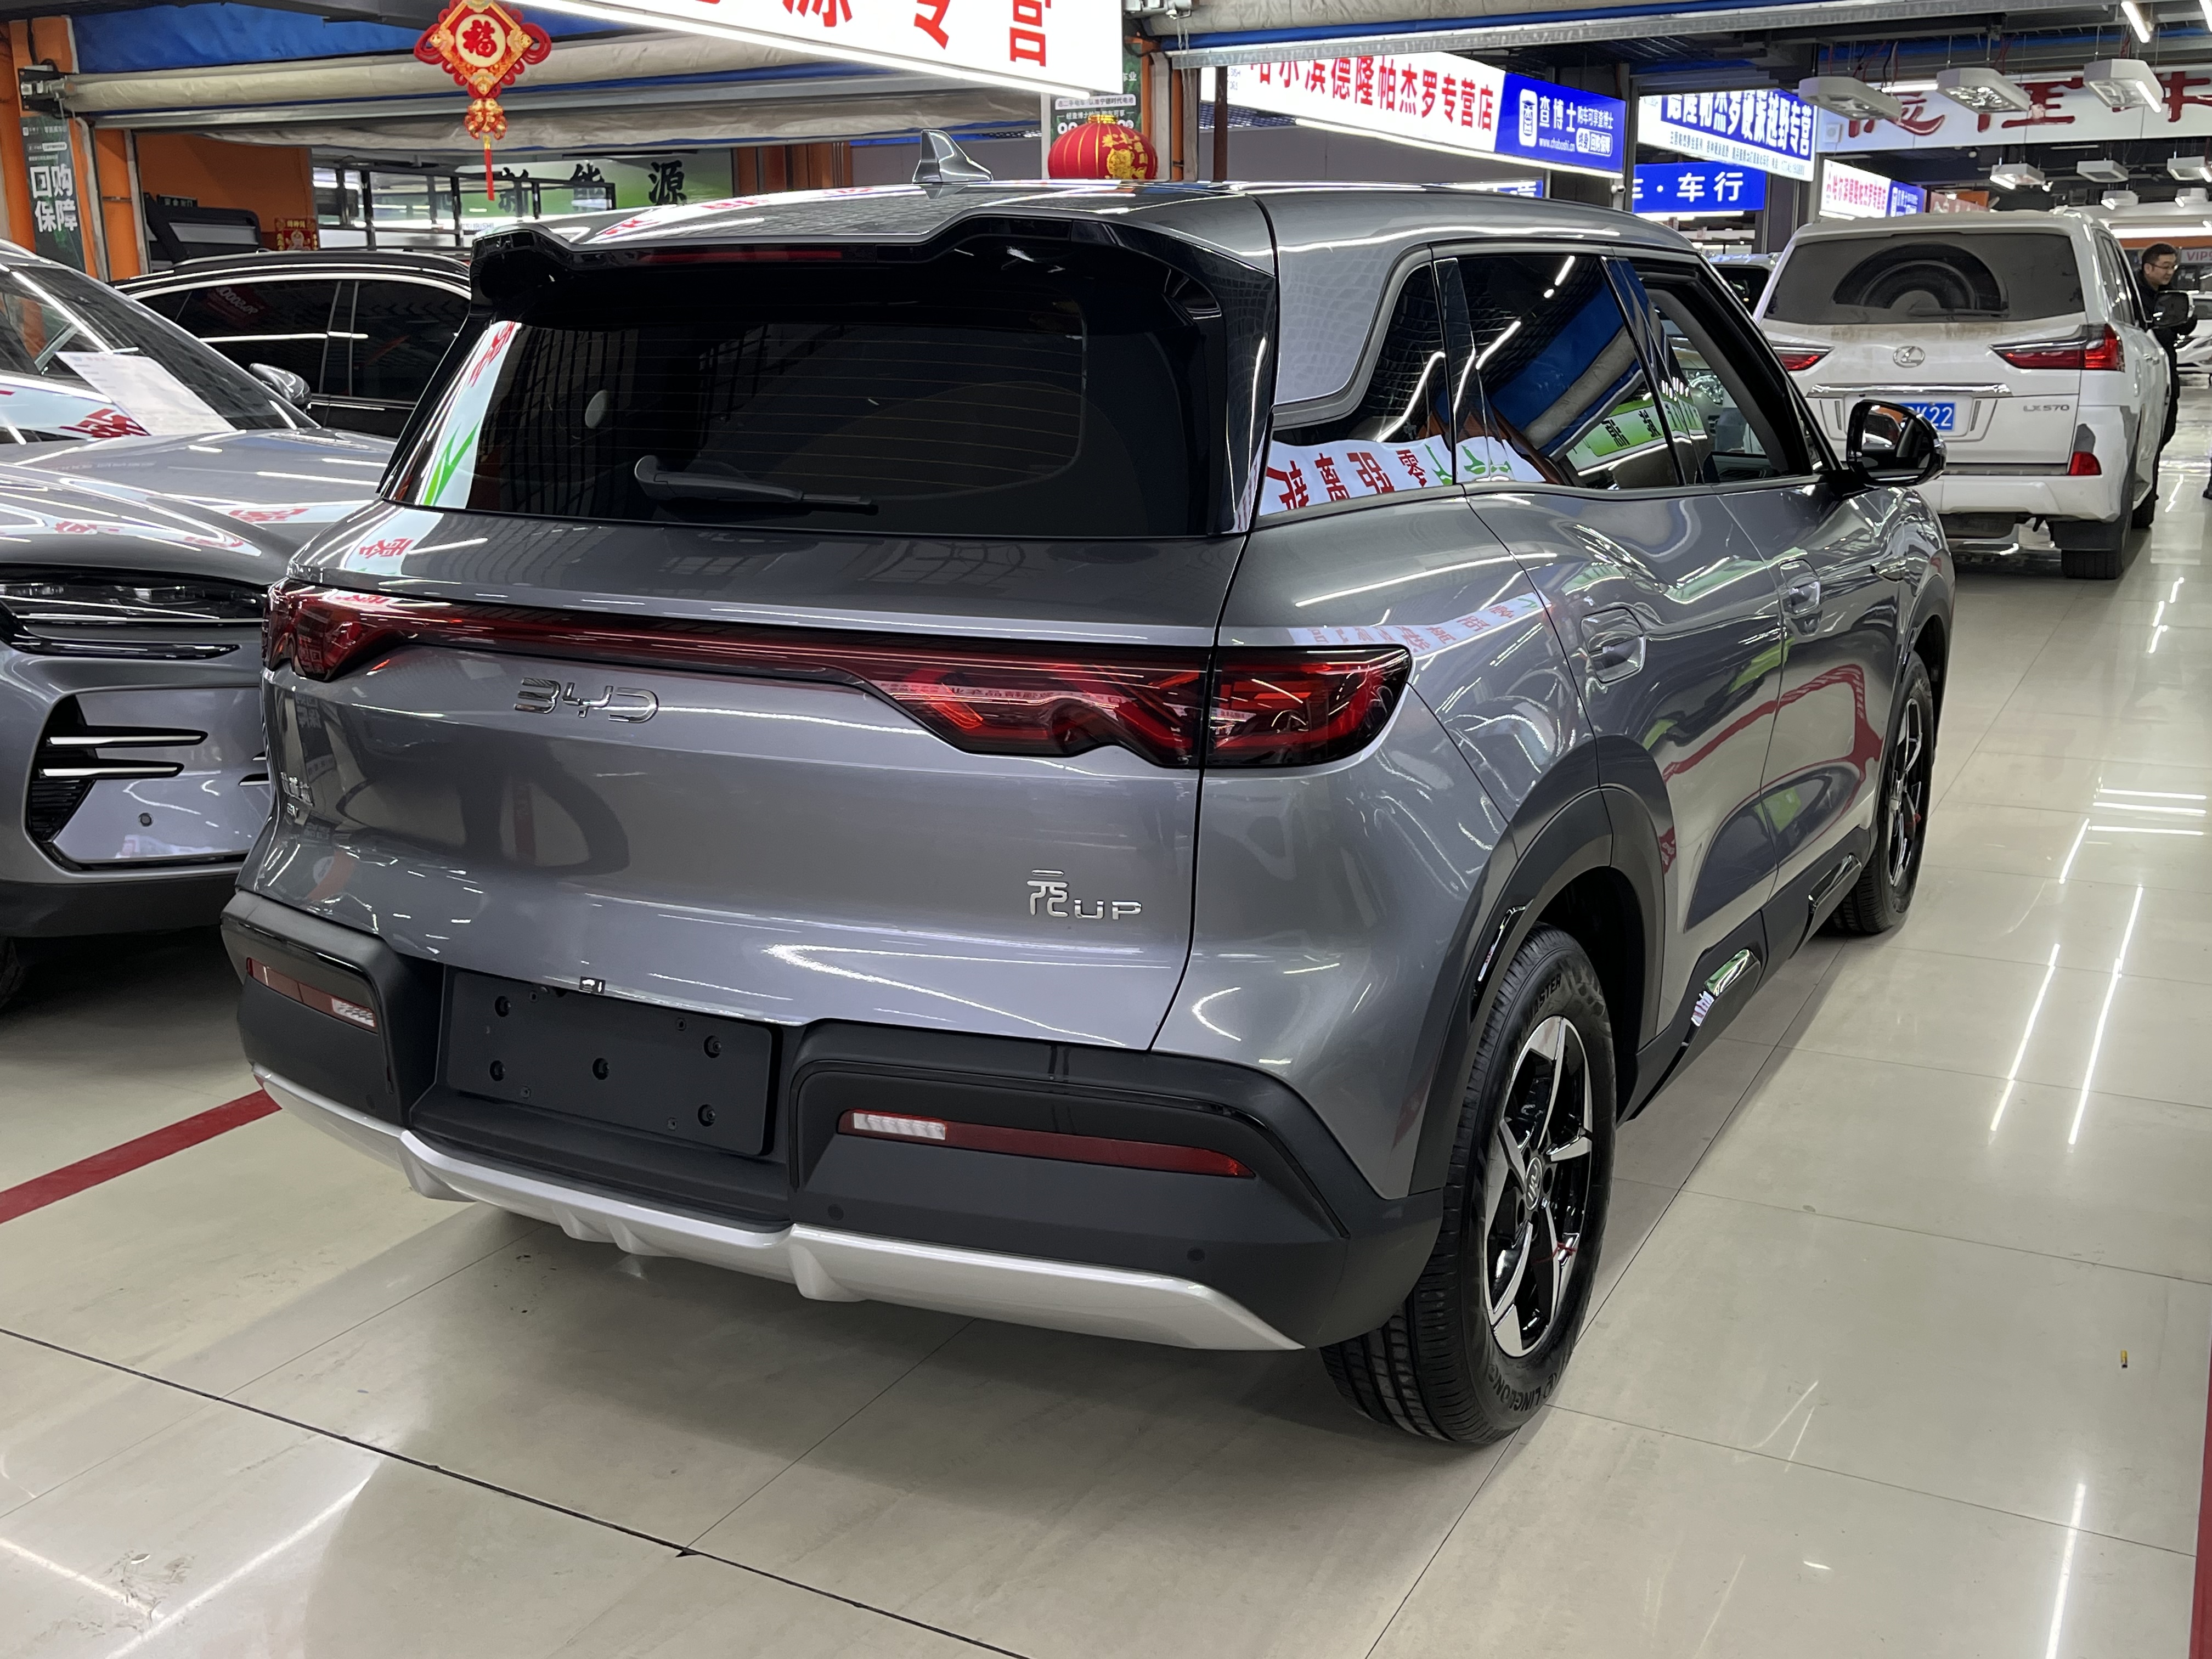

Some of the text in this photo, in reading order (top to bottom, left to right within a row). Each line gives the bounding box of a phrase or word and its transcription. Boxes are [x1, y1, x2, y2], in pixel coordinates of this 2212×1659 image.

[462, 19, 497, 58] 福
[1539, 95, 1576, 132] 查博士
[1577, 105, 1614, 129] 购车可享查博士
[30, 164, 73, 199] 回购
[35, 199, 78, 233] 保障
[1906, 405, 1953, 427] K22
[514, 677, 659, 724] BYD
[1488, 1364, 1541, 1412] LINGLONG
